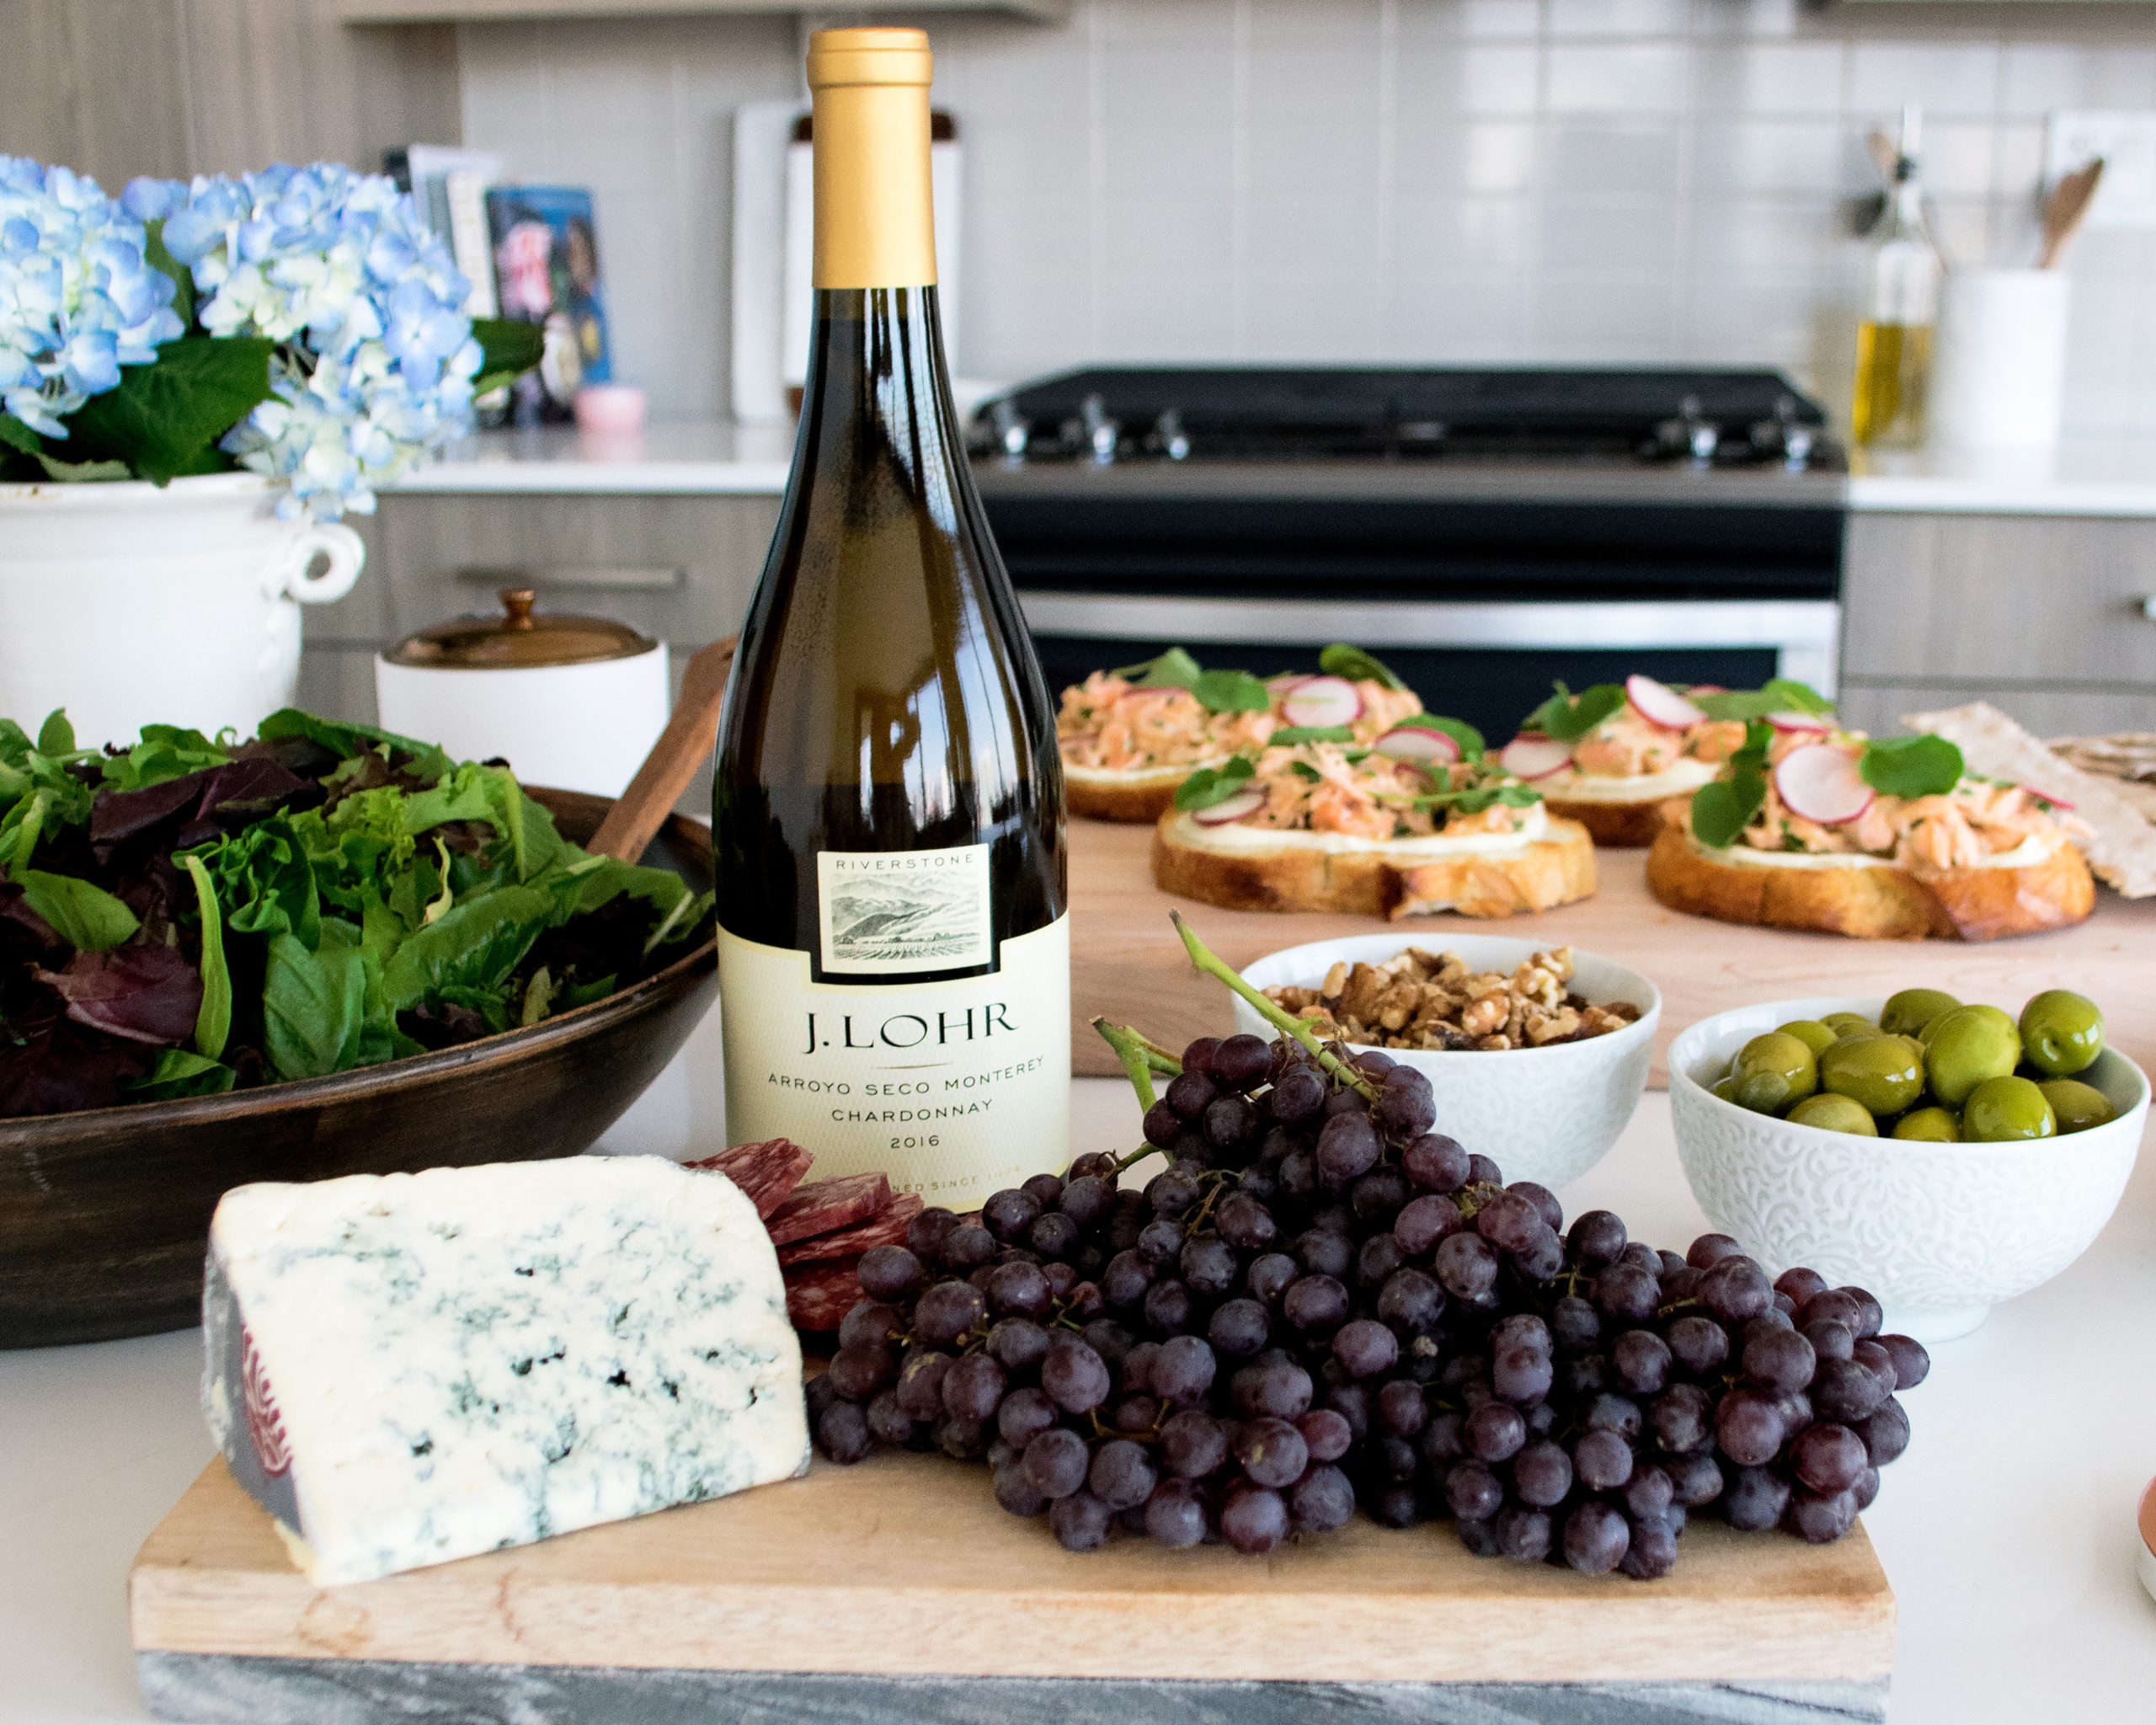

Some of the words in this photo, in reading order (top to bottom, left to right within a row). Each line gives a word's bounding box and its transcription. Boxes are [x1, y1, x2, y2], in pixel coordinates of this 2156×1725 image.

[836, 853, 974, 870] RIVERSTONE
[768, 1073, 851, 1095] ARROYO
[866, 1081, 930, 1096] SECO
[944, 1055, 1044, 1090] MONTEREY
[831, 1098, 993, 1123] CHARDONNAY
[890, 1135, 940, 1149] 2016
[892, 1183, 924, 1193] NED
[931, 1176, 979, 1191] SINCE
